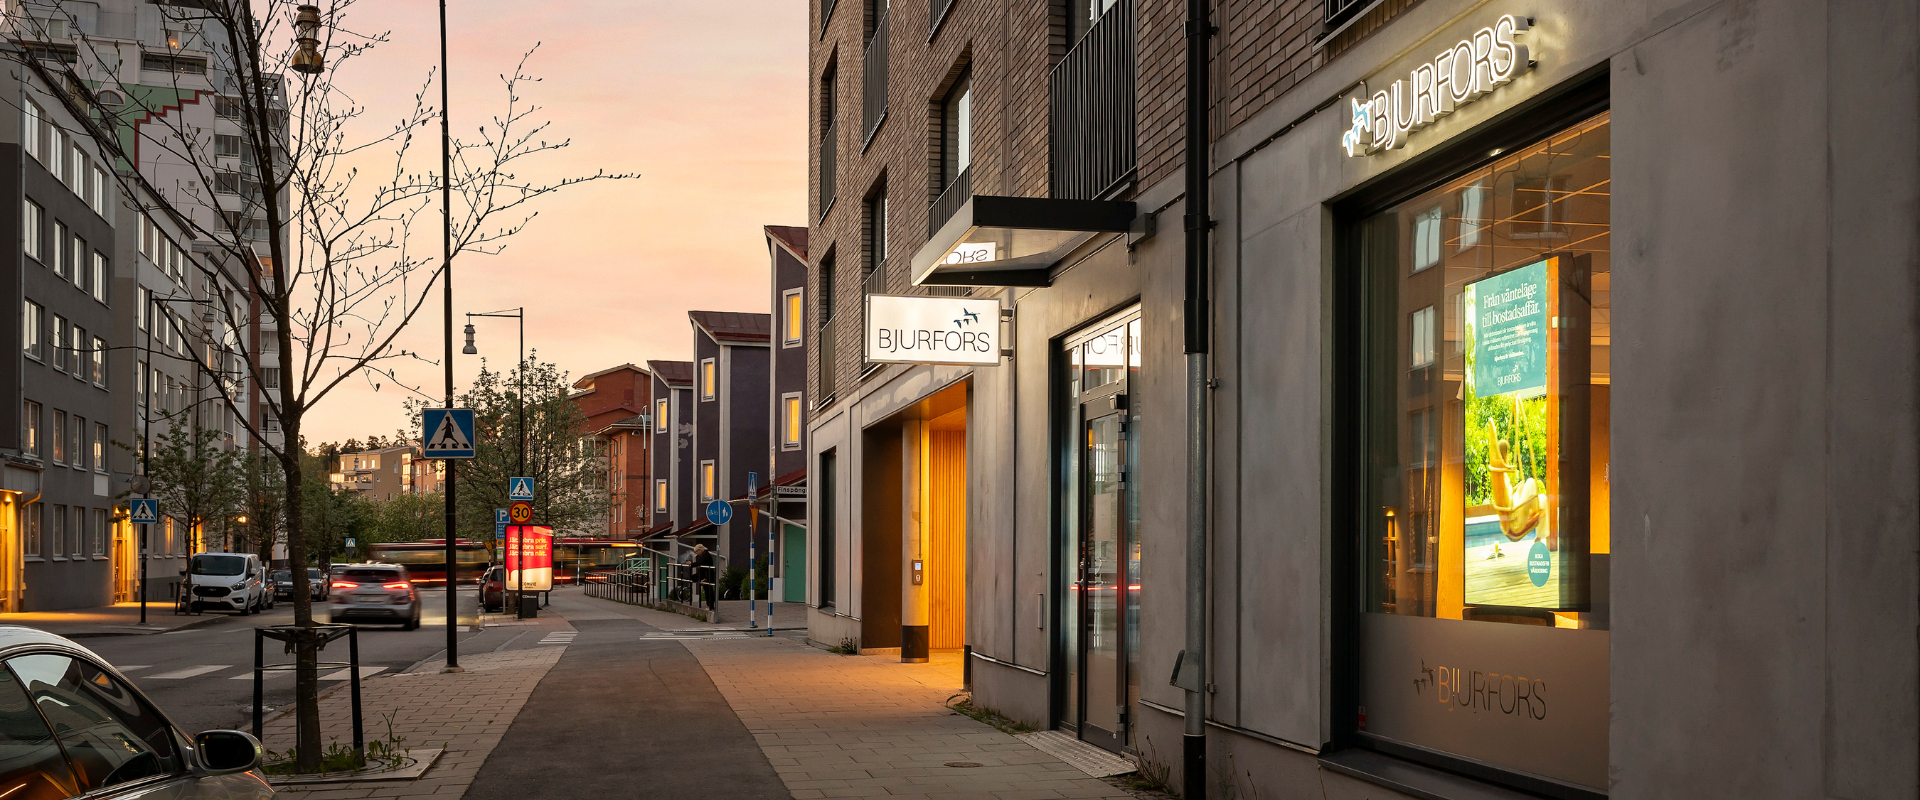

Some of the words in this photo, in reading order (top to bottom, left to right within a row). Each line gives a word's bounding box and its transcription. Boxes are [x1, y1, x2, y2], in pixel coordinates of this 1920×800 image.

[1372, 13, 1516, 151] BJURFORS
[1483, 293, 1500, 309] Från
[1501, 283, 1537, 303] vänteläge
[1482, 311, 1491, 328] till
[1492, 300, 1540, 325] bostadsaffär.
[879, 328, 990, 353] BJURFORS
[1497, 372, 1522, 387] BJURFORS
[499, 510, 508, 521] P
[513, 507, 529, 519] 30
[1438, 665, 1547, 721] BJURFORS
